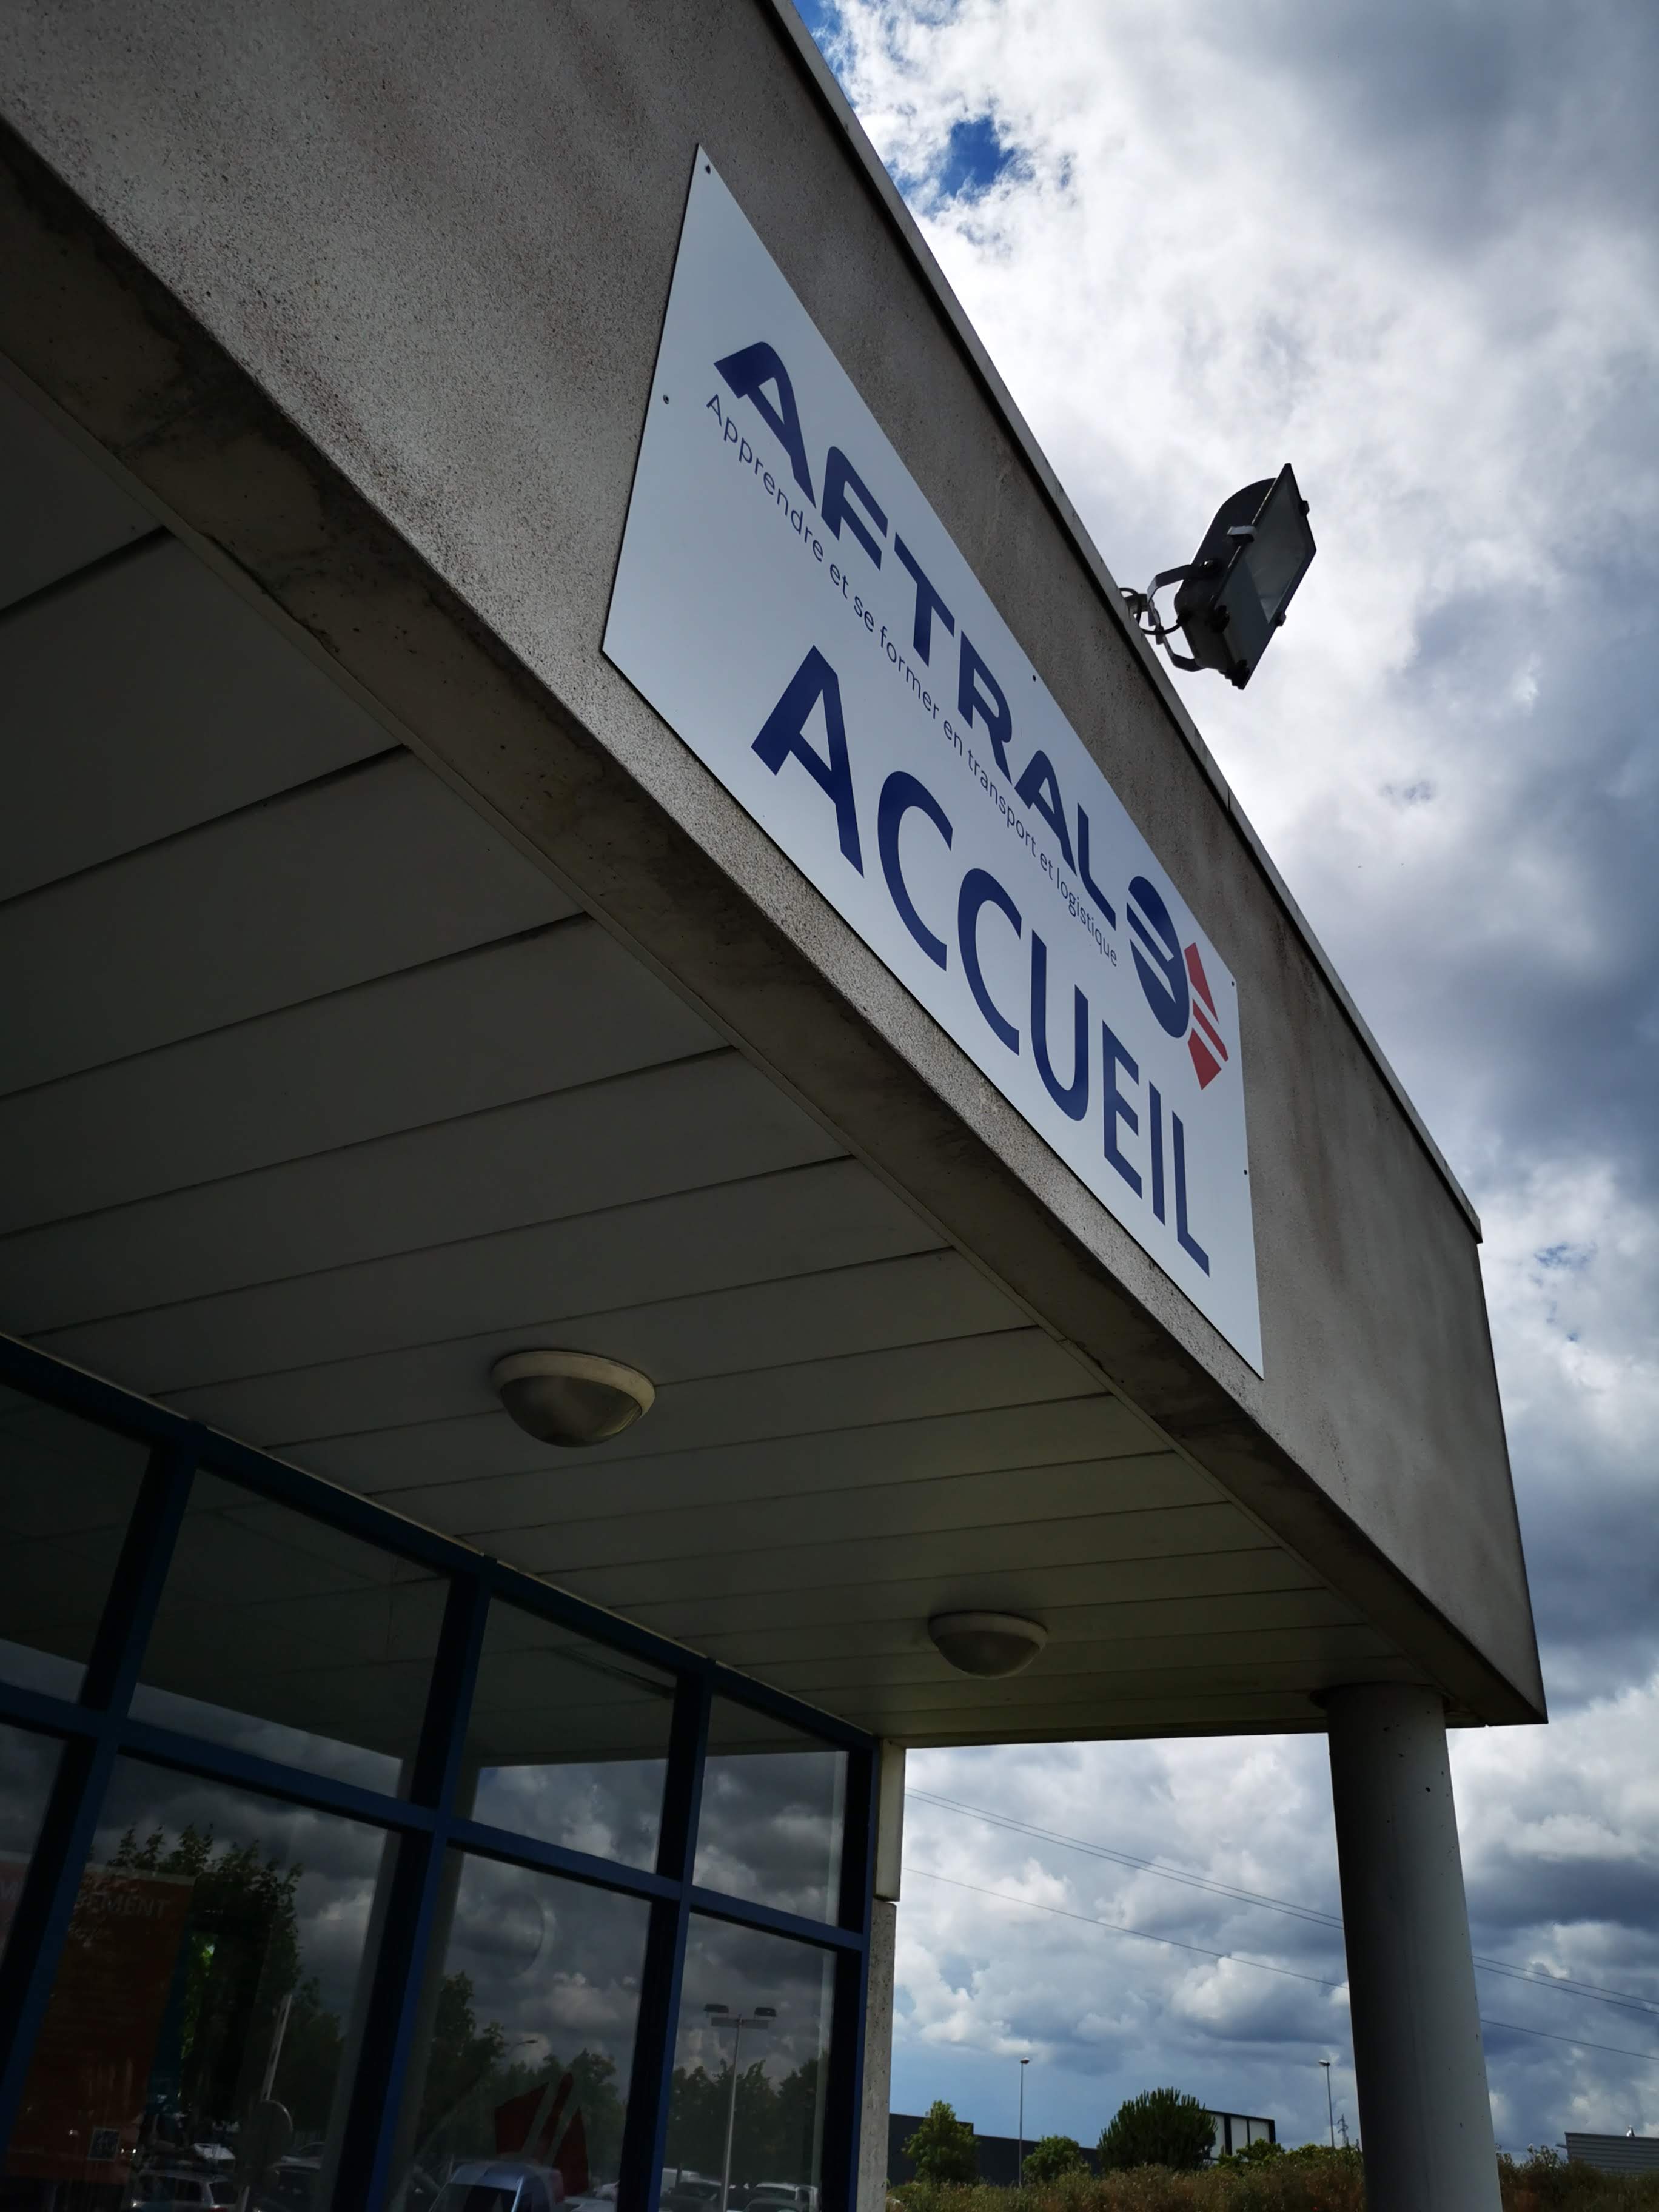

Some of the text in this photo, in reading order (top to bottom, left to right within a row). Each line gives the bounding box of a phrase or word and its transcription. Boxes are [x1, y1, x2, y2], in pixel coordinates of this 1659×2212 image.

[706, 393, 1117, 967] Apprendre et se former en transport et logistique
[713, 341, 1117, 933] AFTRAL
[751, 645, 1210, 1278] ACCUEIL
